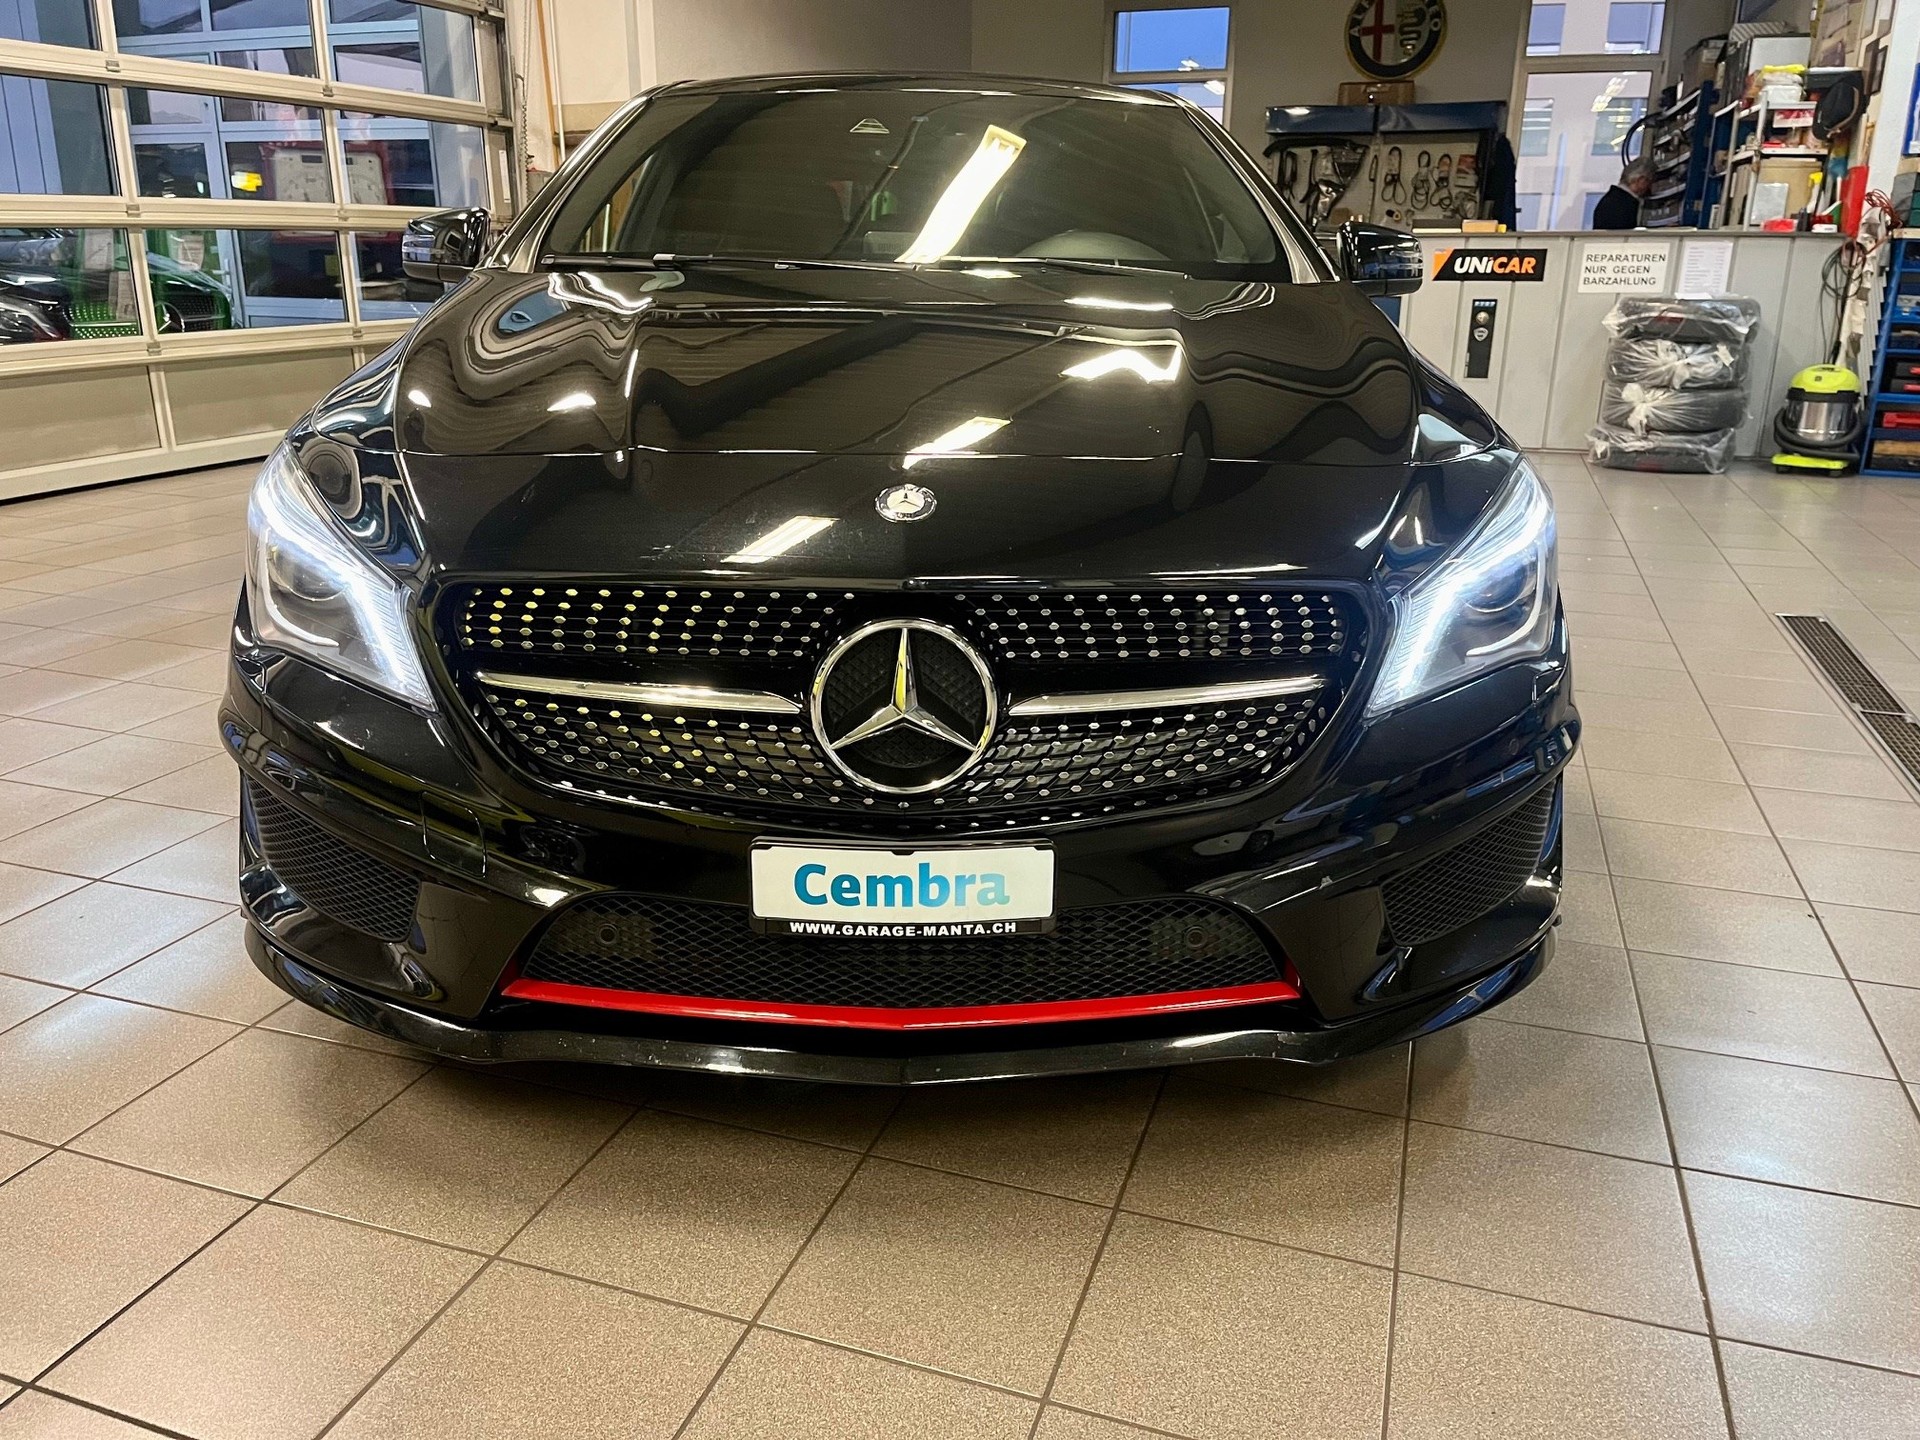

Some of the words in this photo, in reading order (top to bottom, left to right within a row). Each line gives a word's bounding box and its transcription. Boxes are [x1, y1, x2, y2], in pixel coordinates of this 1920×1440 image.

[1586, 253, 1667, 263] REPARATUREN
[1584, 265, 1607, 274] NUR
[1612, 265, 1651, 274] GEGEN
[1582, 276, 1657, 286] BARZAHLUNG
[793, 862, 1011, 908] Cembra
[789, 921, 1017, 938] WWW.GARAGE-MANTA.CH
